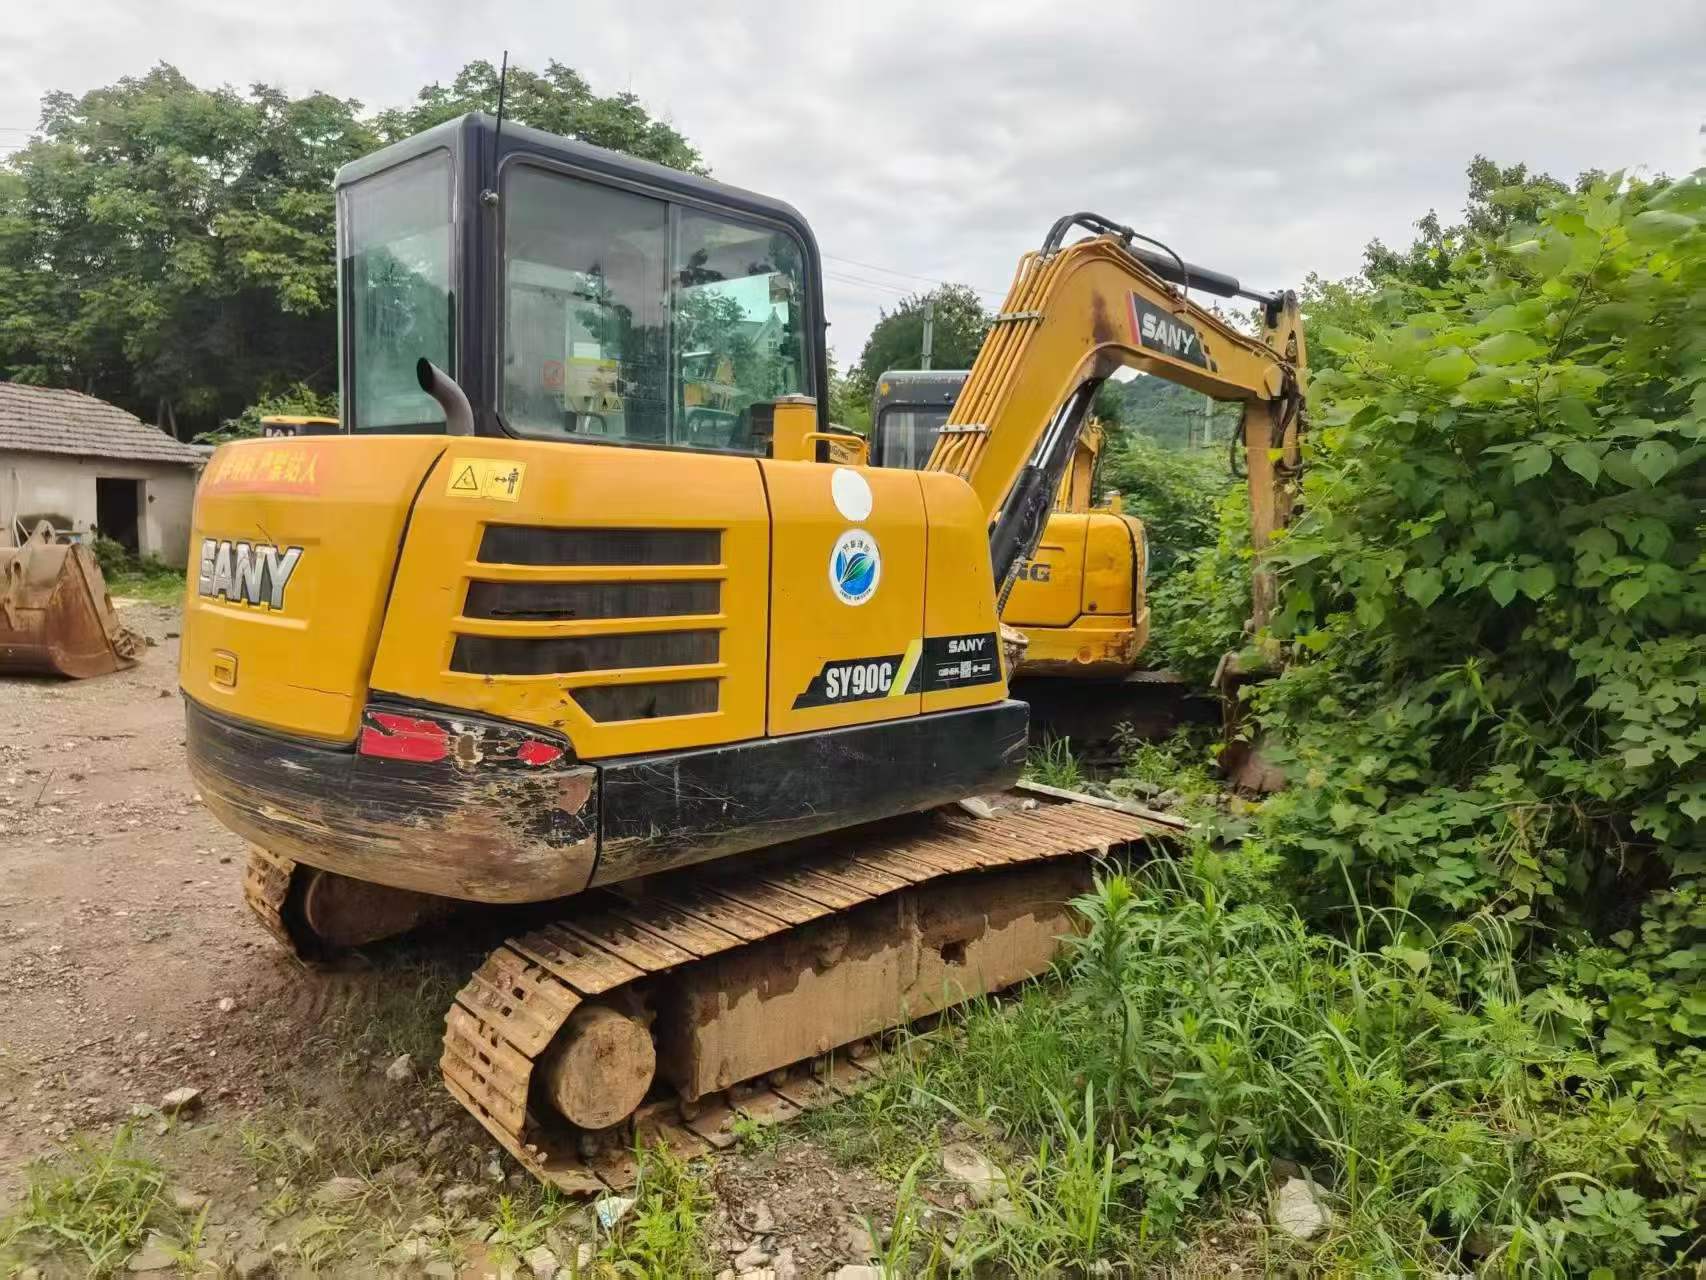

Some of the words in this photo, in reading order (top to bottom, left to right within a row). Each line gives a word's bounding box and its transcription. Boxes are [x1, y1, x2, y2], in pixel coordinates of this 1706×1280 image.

[1142, 312, 1195, 355] SANY
[199, 537, 303, 610] SANY
[948, 637, 986, 654] SANY
[826, 661, 893, 699] SY90C
